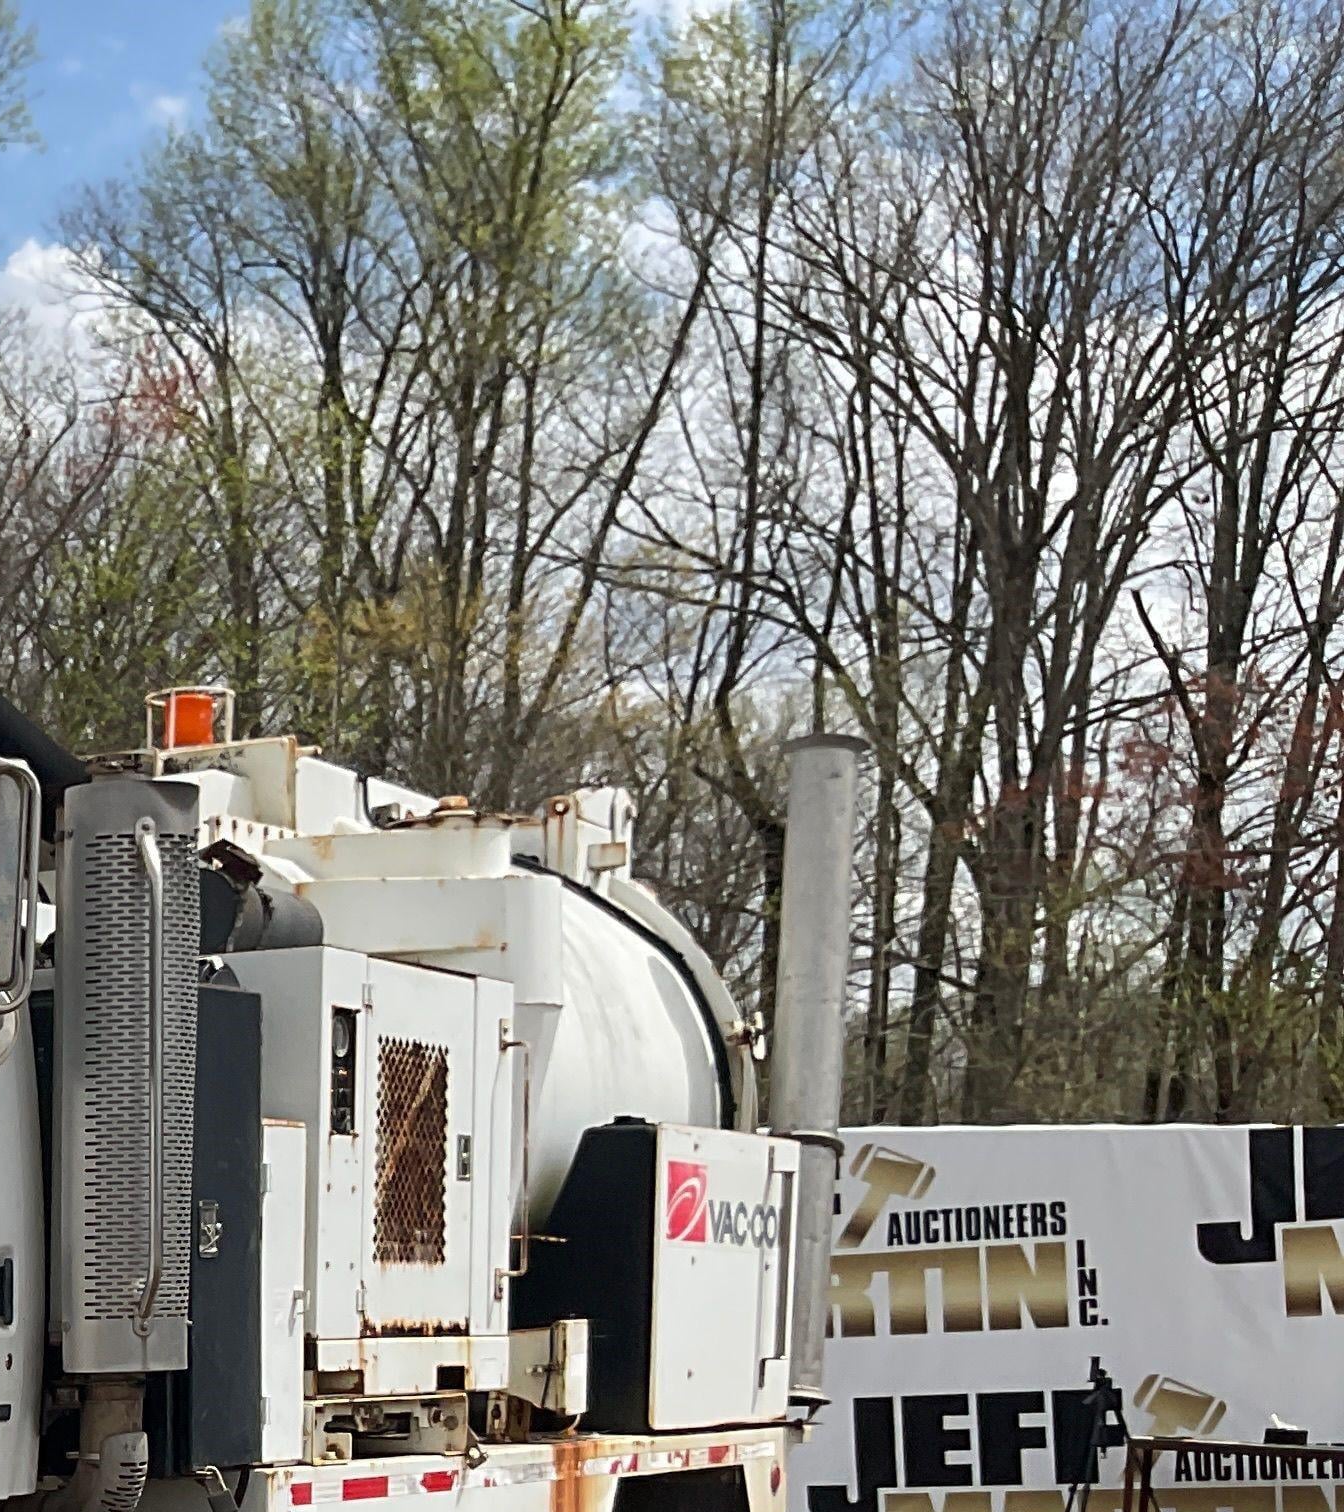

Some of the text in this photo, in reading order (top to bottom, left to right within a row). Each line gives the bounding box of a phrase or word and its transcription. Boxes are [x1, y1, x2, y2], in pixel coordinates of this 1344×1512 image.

[887, 1201, 1067, 1246] AUCTIONEERS
[825, 1242, 1070, 1338] RTIN
[1076, 1239, 1109, 1326] INC.
